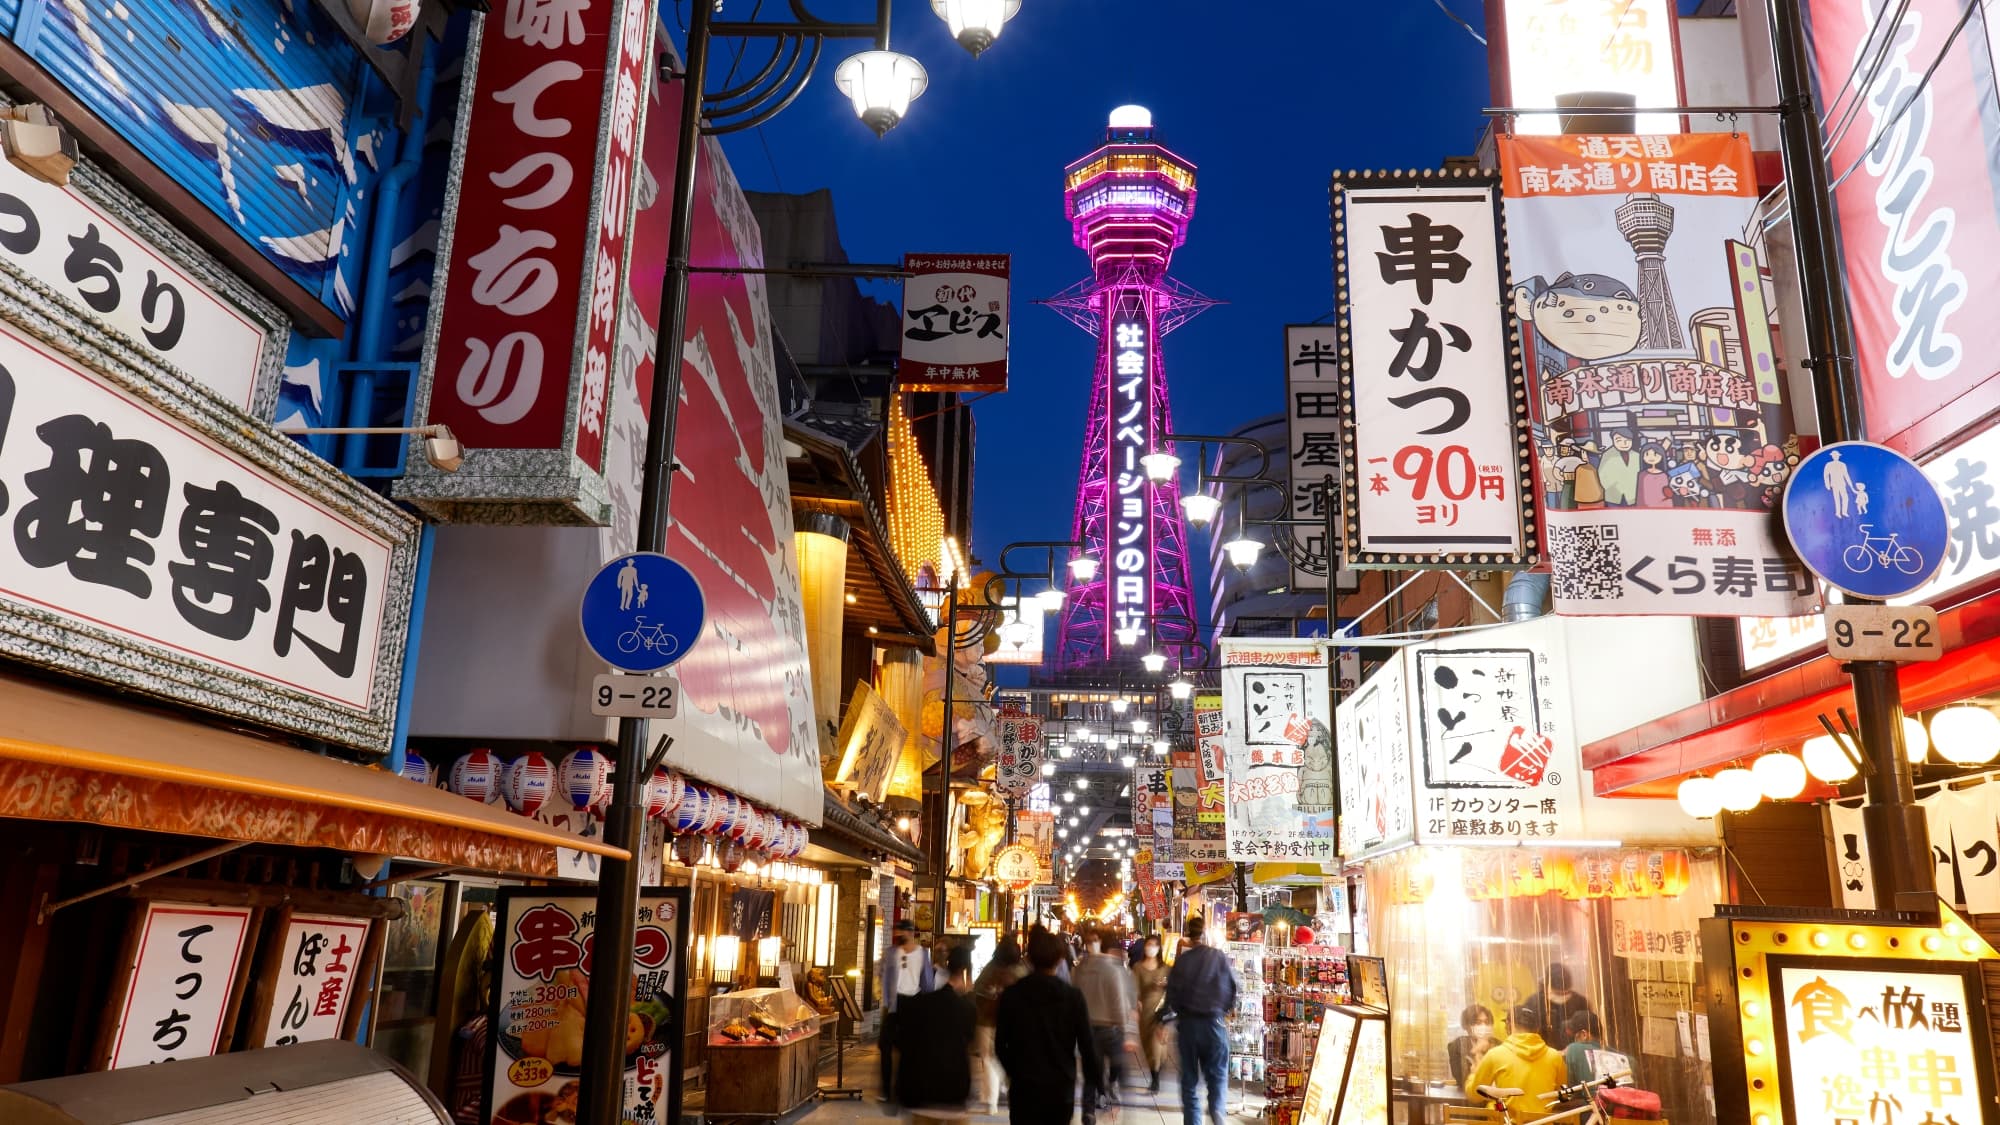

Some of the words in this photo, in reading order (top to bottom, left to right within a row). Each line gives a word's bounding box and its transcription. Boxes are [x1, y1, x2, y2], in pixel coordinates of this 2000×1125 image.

[1578, 135, 1674, 160] 通天閣
[1518, 160, 1739, 195] 南本通り商店会
[936, 285, 977, 304] 初代
[904, 303, 1004, 342] エビス
[1374, 212, 1473, 435] 串かつ
[925, 366, 981, 380] 年中無休
[1546, 364, 1756, 406] 南本通り商店街
[1116, 323, 1145, 642] 社会イノベーションの日立
[0, 362, 368, 678] 理専門
[1416, 503, 1460, 527] ヨリ
[1691, 527, 1738, 547] 無添
[1625, 555, 1815, 598] くら寿司
[1495, 668, 1521, 723] 新世界
[1017, 721, 1039, 776] 串かつ
[1200, 738, 1216, 779] 大阪名物
[527, 780, 546, 789] Asahi
[572, 772, 592, 780] Asahi
[1429, 798, 1446, 812] 1F
[1451, 798, 1558, 815] カウンター席
[1429, 820, 1446, 834] 2F
[1451, 820, 1559, 837] 座敷あります
[1189, 849, 1227, 859] くら寿司
[1231, 840, 1330, 857] 宴会予約受付中
[274, 931, 329, 1047] ぽん
[313, 934, 353, 1017] 土産
[536, 985, 577, 1003] 380円
[150, 924, 214, 1065] てっち
[1791, 976, 1962, 1045] 食べ放題
